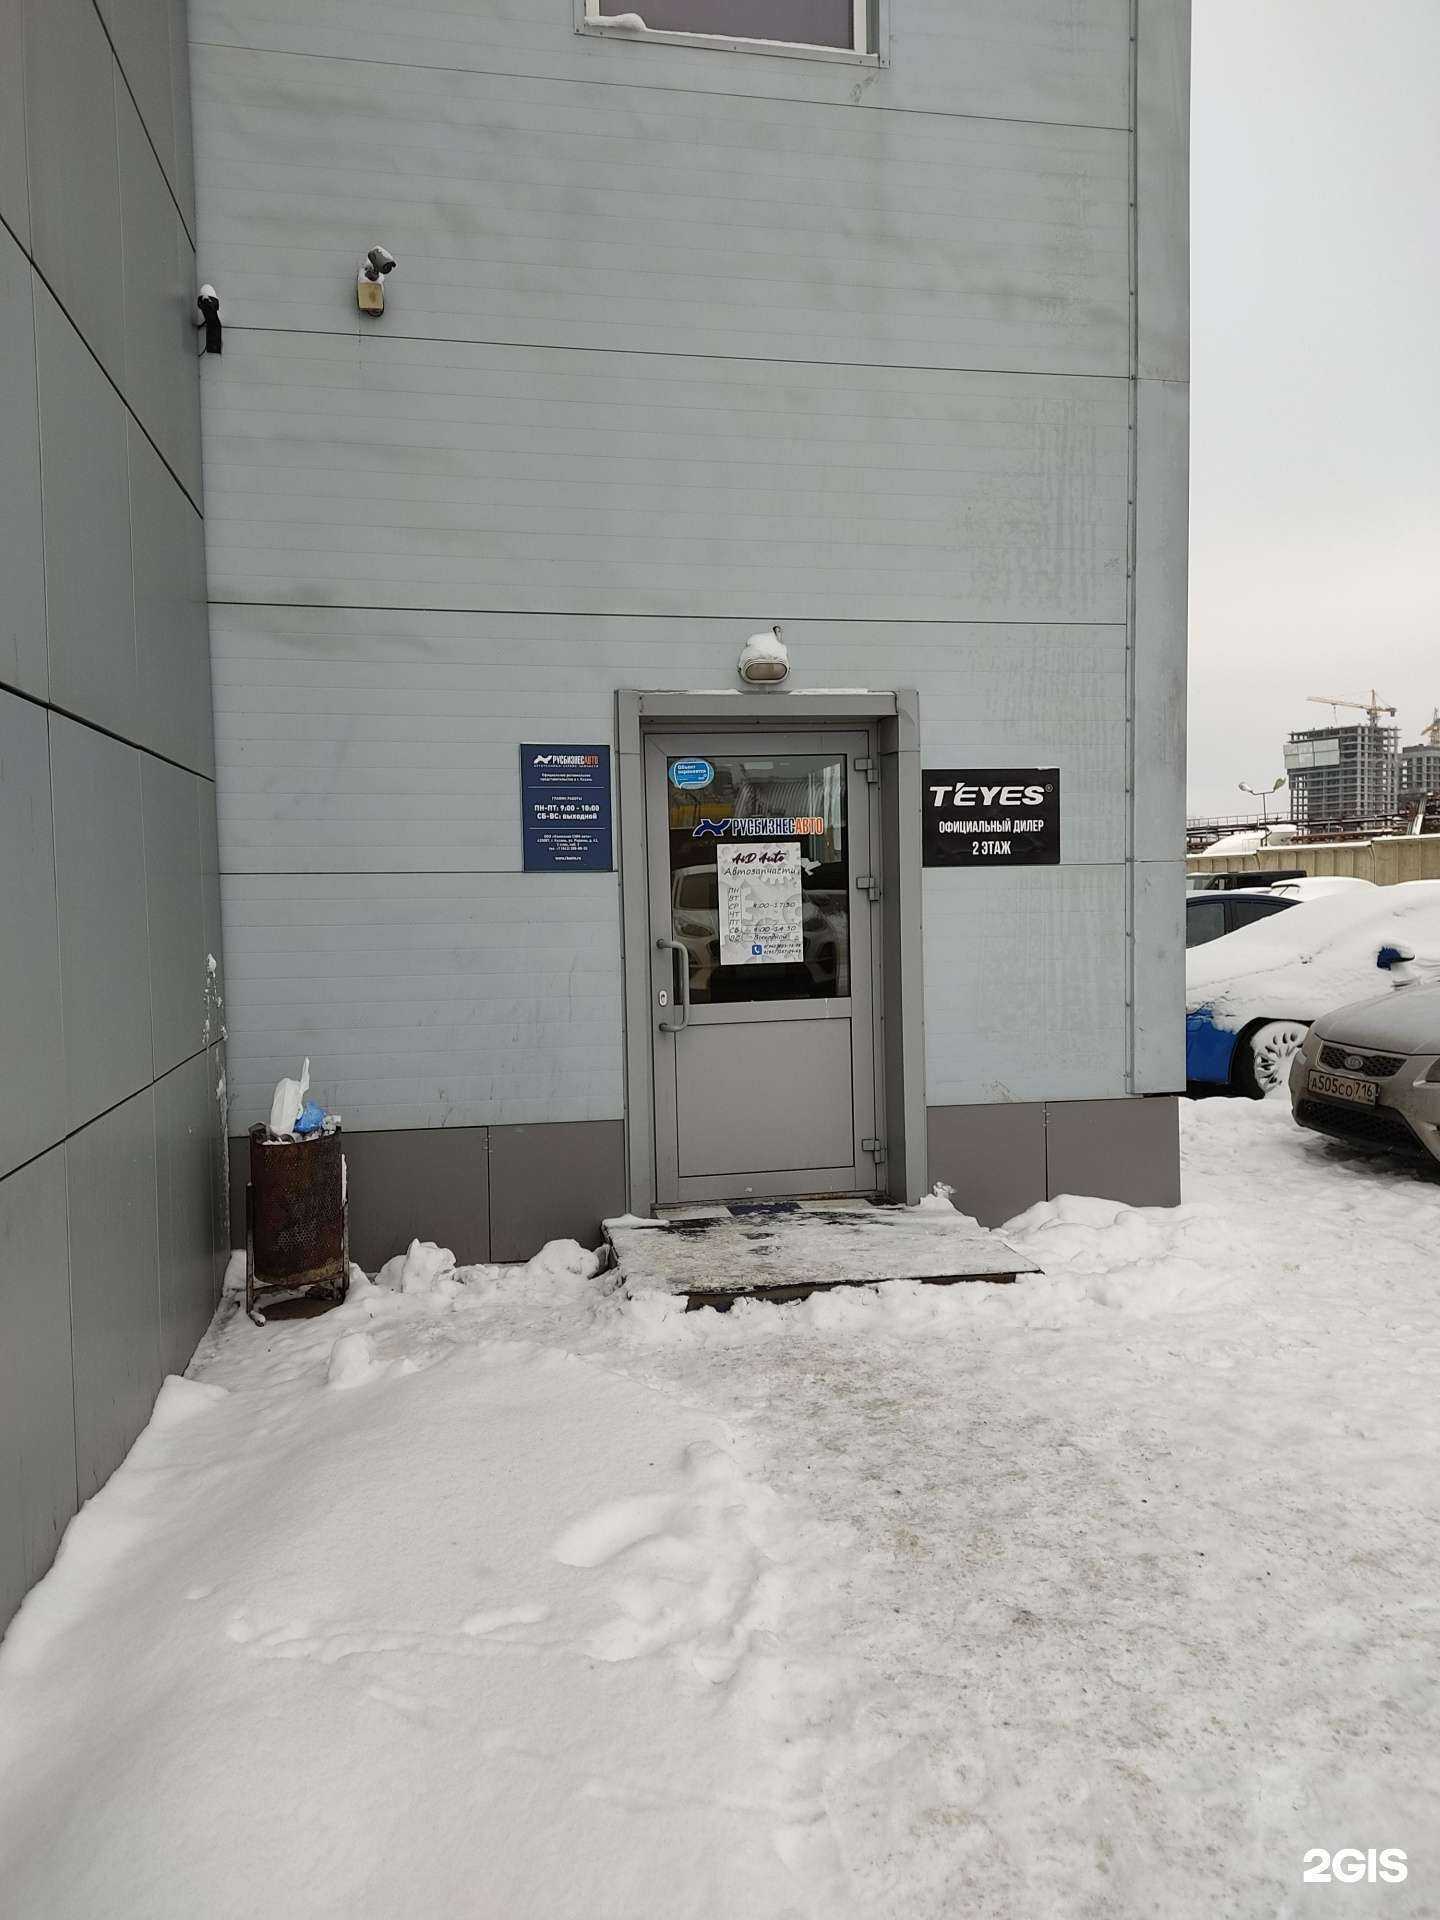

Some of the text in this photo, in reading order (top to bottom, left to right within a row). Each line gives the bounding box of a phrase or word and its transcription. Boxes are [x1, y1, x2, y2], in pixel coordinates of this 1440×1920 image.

[534, 804, 559, 812] ПН-ПТ:
[536, 812, 598, 820] СБ-ВС: выходной
[731, 817, 824, 837] РУСБИЗНЕСАВТО
[938, 818, 1044, 834] ОФИЦИАЛЬНЫЙ ДИЛЕР
[972, 840, 1012, 855] 2 ЭТАЖ
[758, 850, 787, 865] Auto
